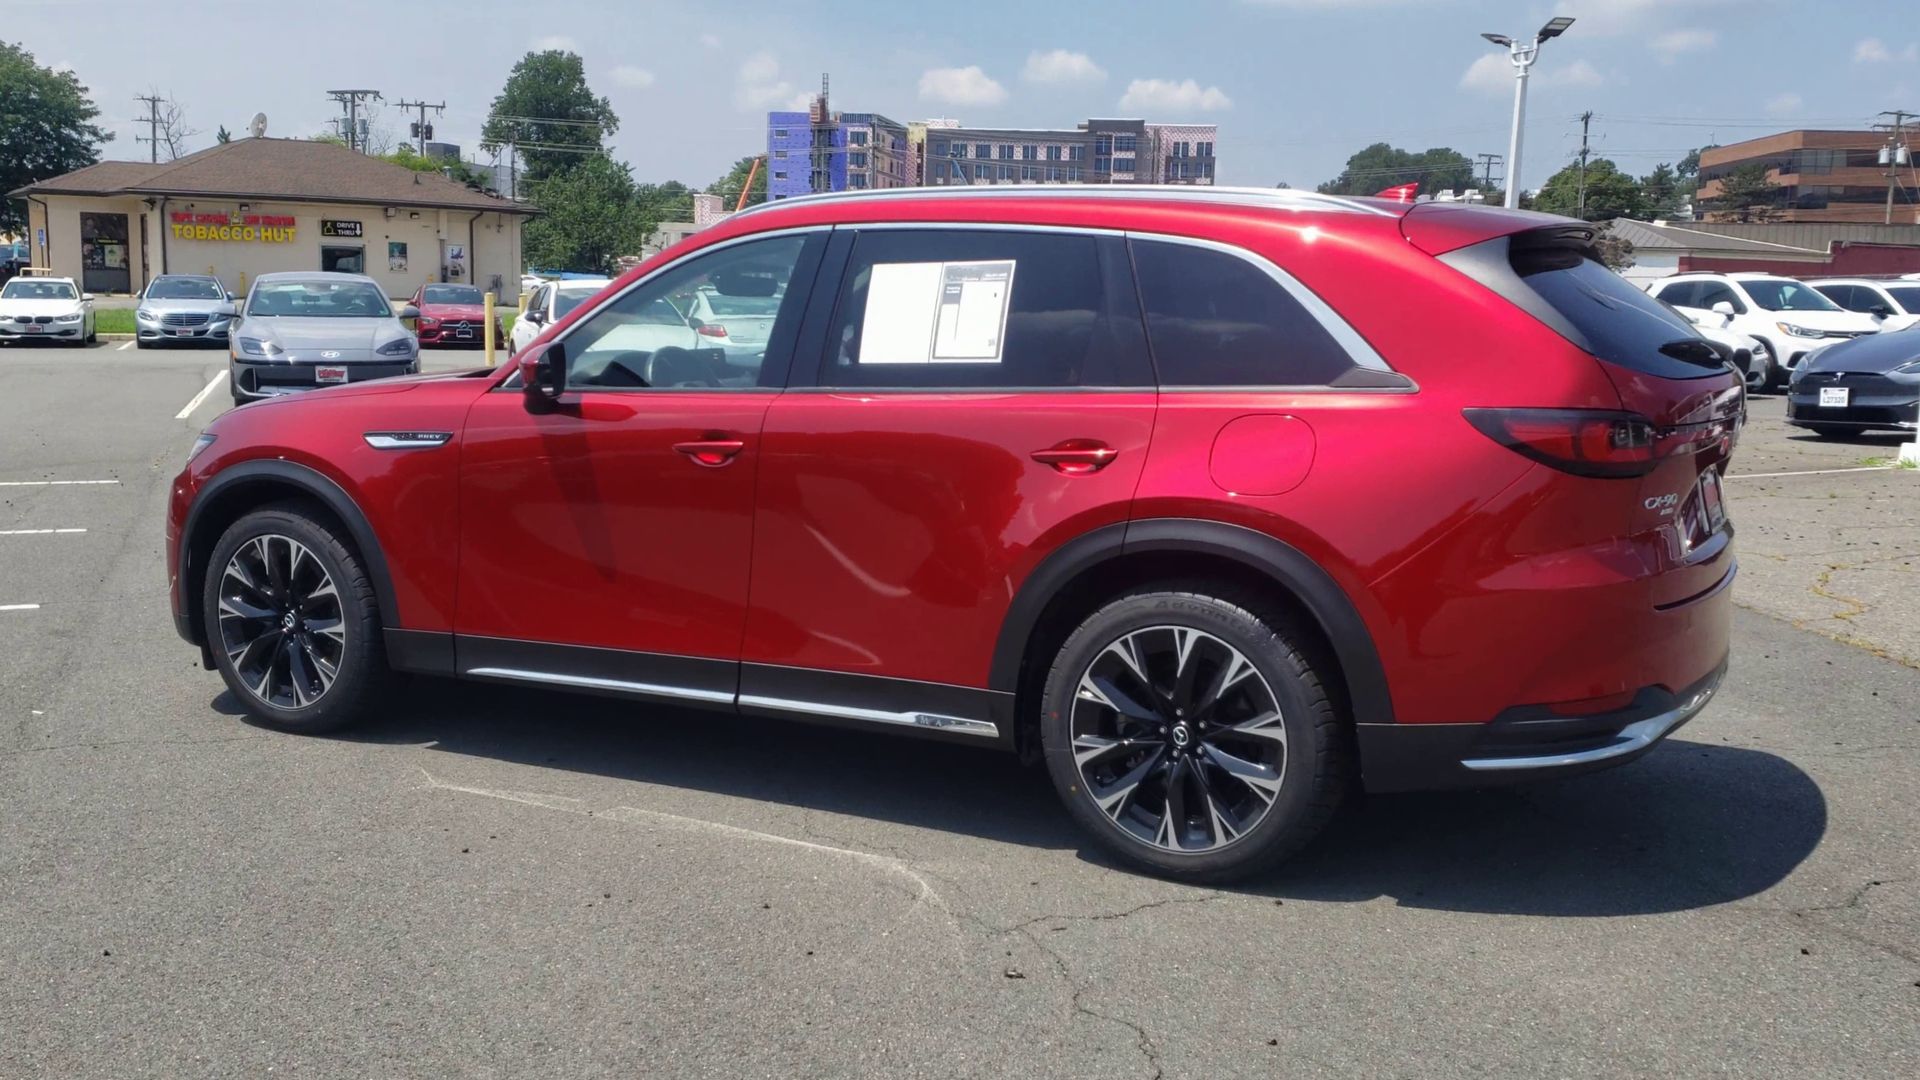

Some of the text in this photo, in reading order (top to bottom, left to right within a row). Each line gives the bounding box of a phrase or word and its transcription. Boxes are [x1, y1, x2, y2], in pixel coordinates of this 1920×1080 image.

[171, 224, 297, 243] TOBACCO HUT
[1644, 493, 1678, 510] CX-90
